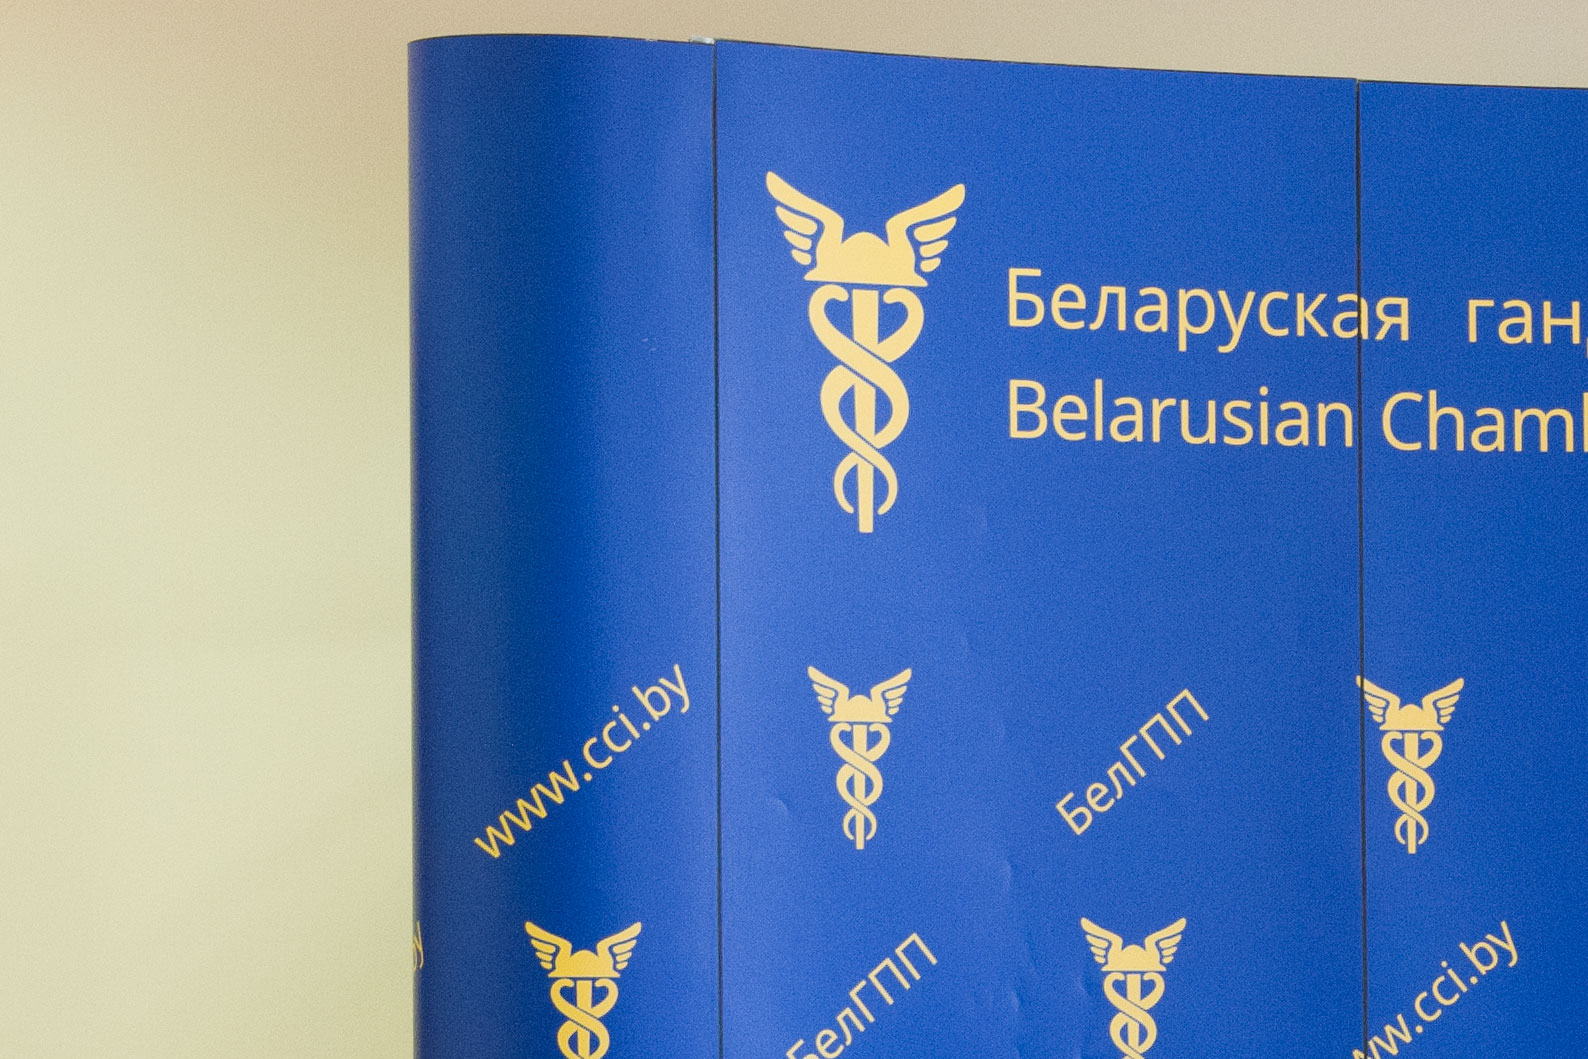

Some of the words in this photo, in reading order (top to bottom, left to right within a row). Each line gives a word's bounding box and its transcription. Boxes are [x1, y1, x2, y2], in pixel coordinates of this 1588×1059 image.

[1007, 267, 1410, 354] Беларуская
[1008, 377, 1355, 448] Belarusian
[473, 663, 691, 860] www.cci.by
[1055, 688, 1210, 836] БелГПП
